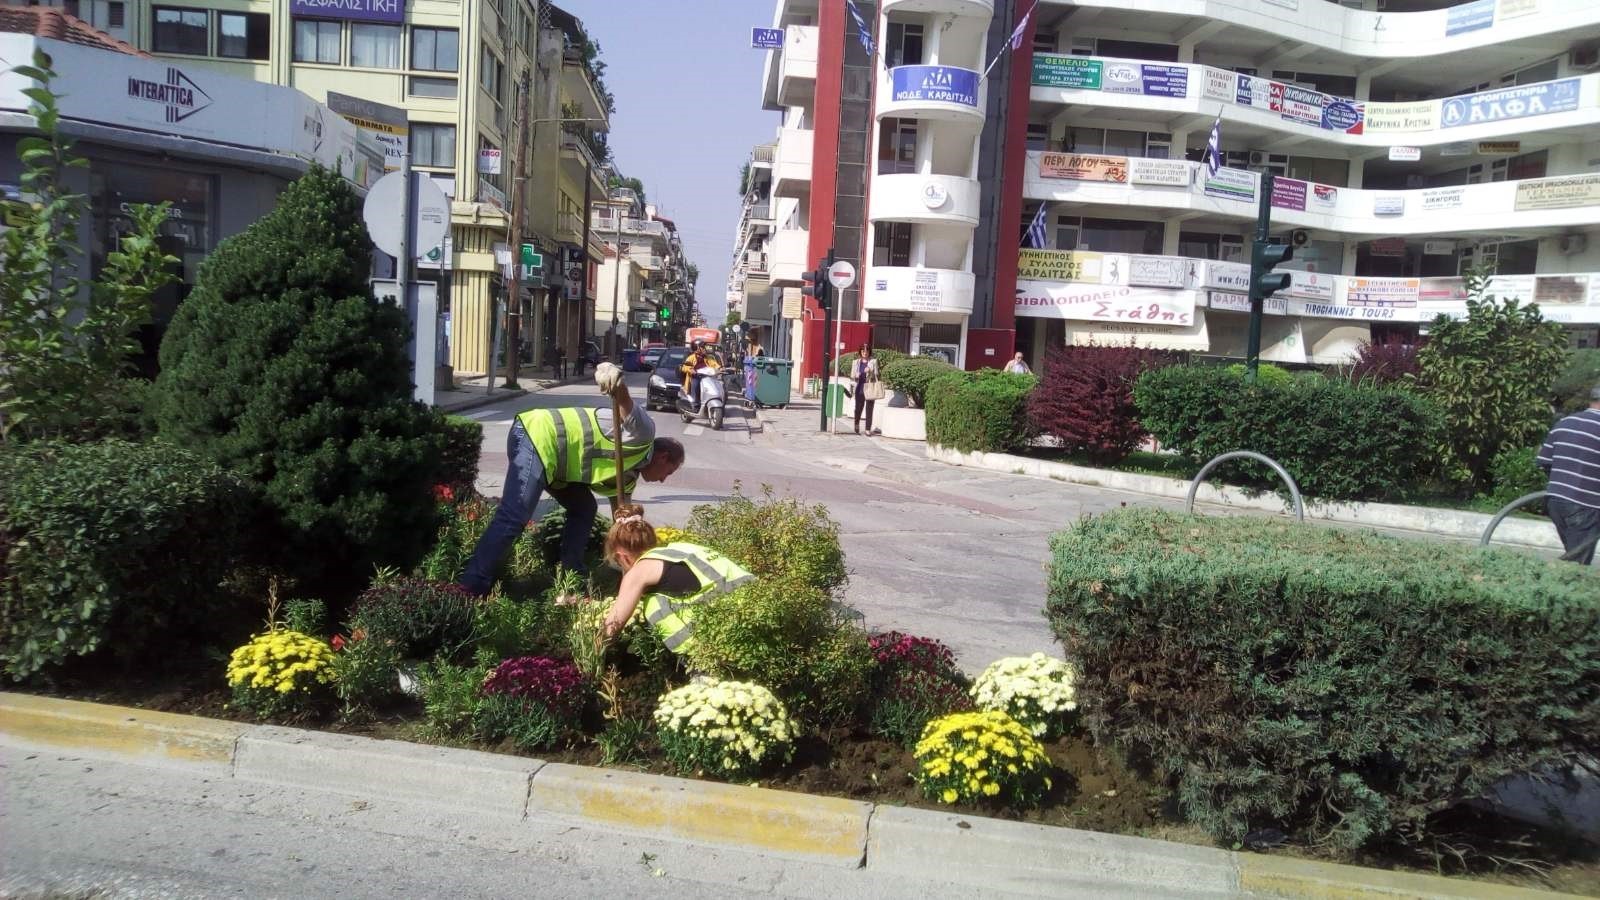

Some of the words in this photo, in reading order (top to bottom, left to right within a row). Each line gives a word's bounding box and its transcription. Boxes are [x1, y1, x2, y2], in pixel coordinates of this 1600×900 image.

[1045, 57, 1088, 67] ΘΕΜΕΛΙΟ
[128, 78, 194, 107] INTERATTICA
[927, 90, 976, 105] ΚΑΡΔΙΤΣΑΣ
[1470, 85, 1548, 103] ΦΡΟΝΤΙΣΤΗΡΙΑ
[1469, 96, 1546, 122] ΑΛΦΑ
[481, 150, 501, 158] ERGO
[1044, 155, 1066, 166] ΠΕΡΙ
[1068, 156, 1100, 168] ΛΟΓΟΥ
[1029, 260, 1082, 269] ΣΥΛΛΟΓΟΣ
[1017, 268, 1081, 280] ΚΑΡΔΙΤΣΑΣ
[1093, 302, 1189, 323] Στάθης
[1305, 303, 1355, 317] TIROGIANNIS
[1361, 308, 1396, 319] TOURS
